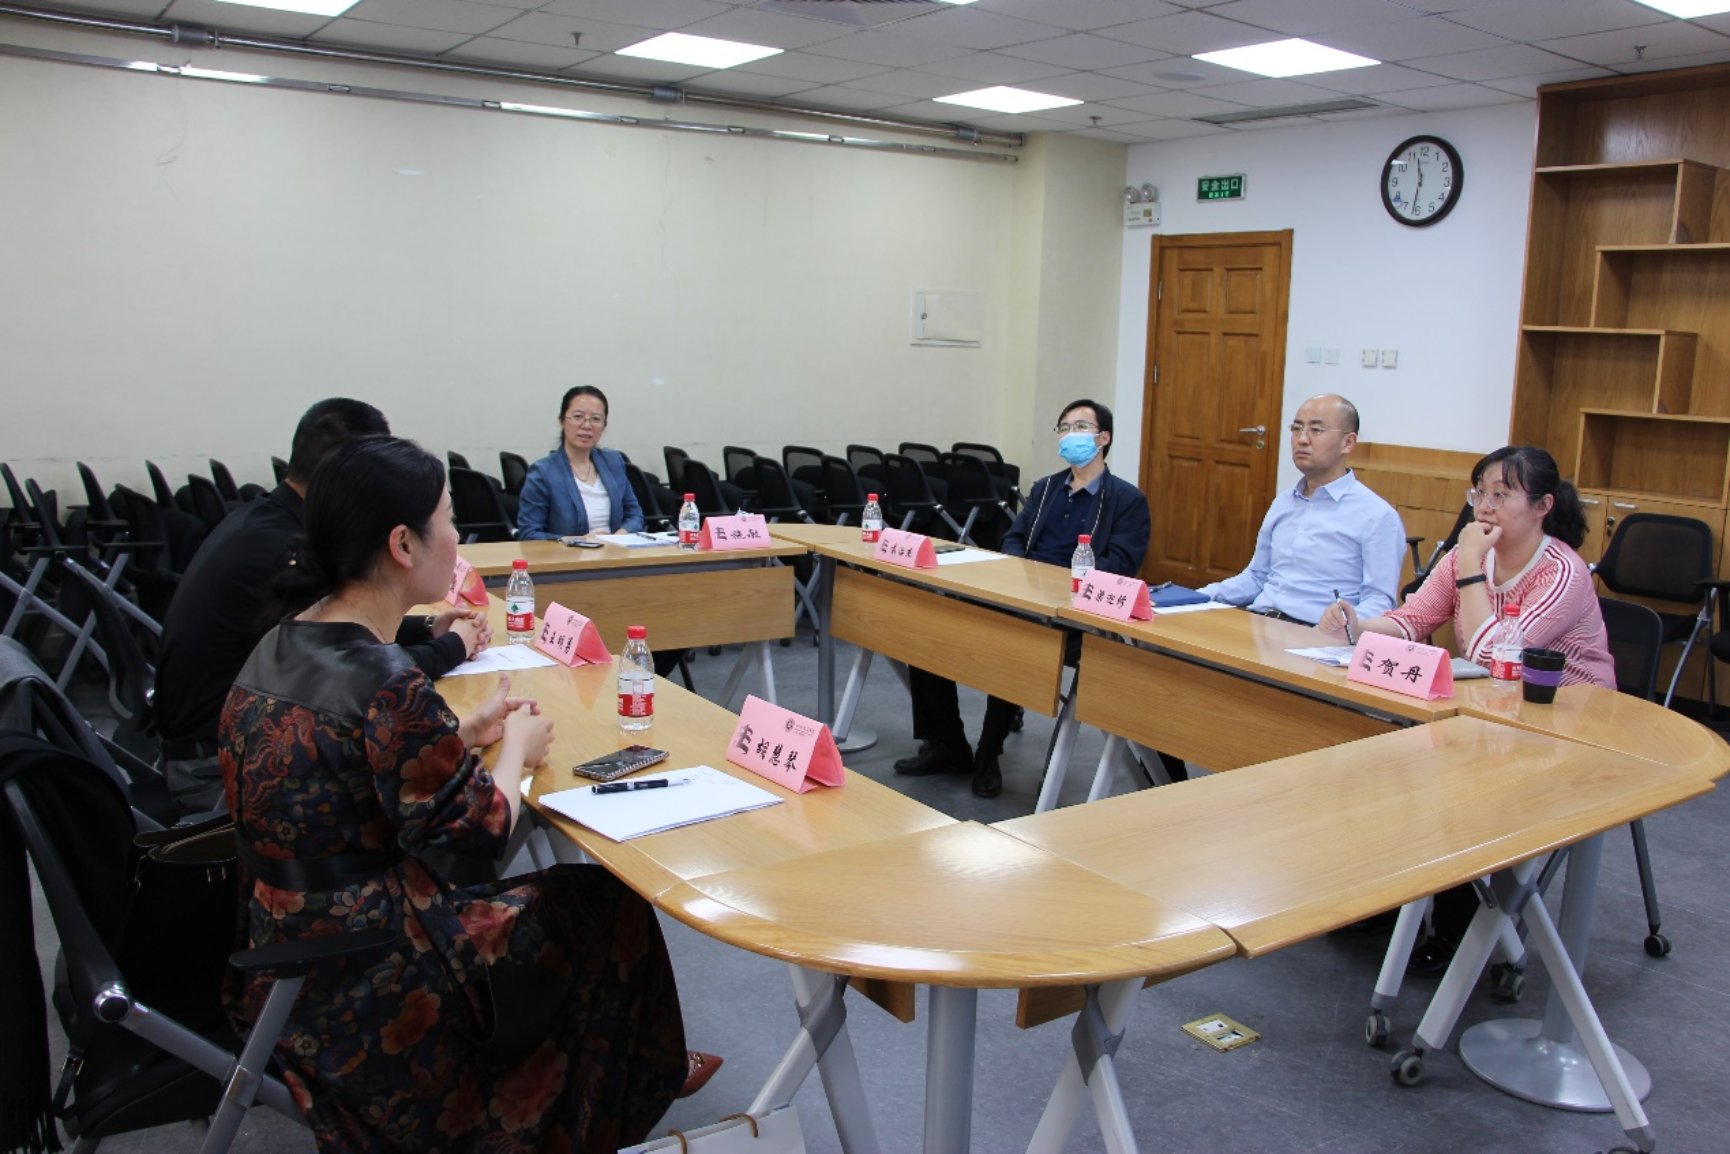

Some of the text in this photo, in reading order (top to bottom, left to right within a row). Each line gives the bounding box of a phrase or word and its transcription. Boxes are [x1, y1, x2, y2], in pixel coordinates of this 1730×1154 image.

[1408, 152, 1416, 160] 11
[1420, 146, 1430, 156] 12
[1442, 162, 1448, 172] 2
[1200, 178, 1239, 192] 安全出口
[1392, 177, 1398, 187] 9
[1444, 176, 1451, 187] 3
[1438, 192, 1444, 201] 4
[1403, 202, 1408, 210] 7
[1415, 206, 1422, 216] 6
[1428, 202, 1435, 212] 5
